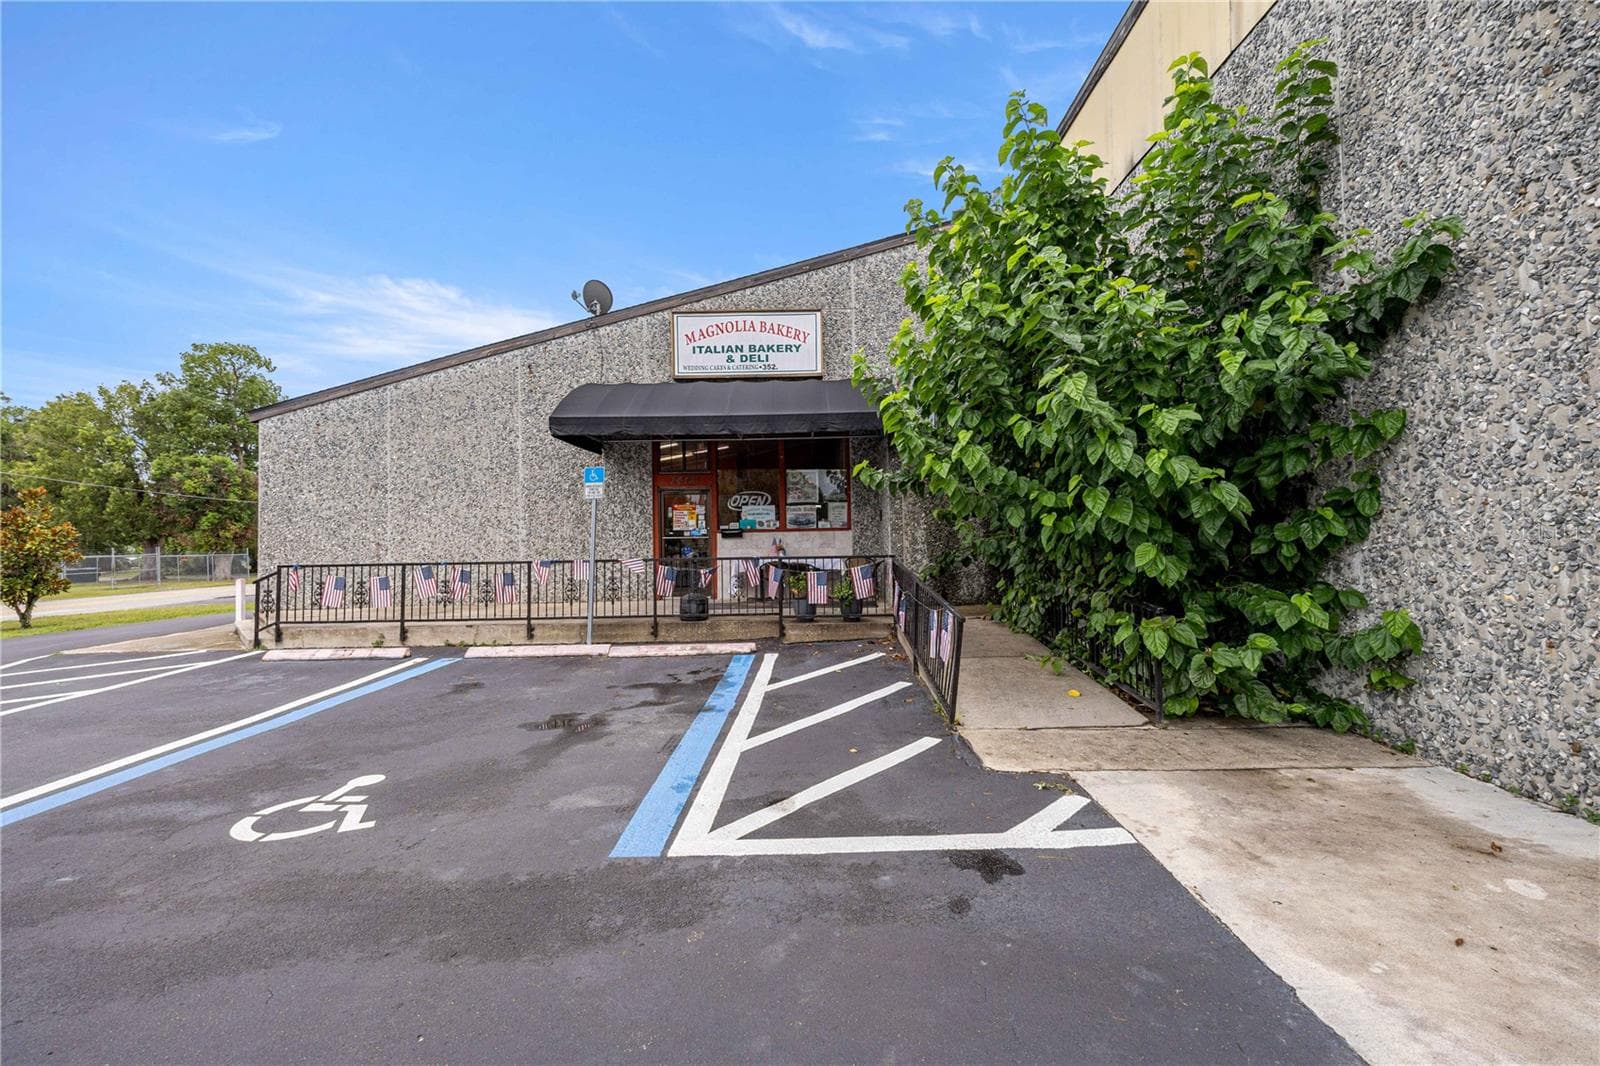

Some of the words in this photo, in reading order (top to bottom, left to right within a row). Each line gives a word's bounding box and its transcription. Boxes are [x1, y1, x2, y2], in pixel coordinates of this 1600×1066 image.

[684, 319, 756, 345] MAGNOLIA
[759, 320, 811, 344] BAKERY
[692, 345, 744, 354] ITALIAN
[748, 344, 802, 353] BAKERY
[726, 354, 735, 363] &
[740, 354, 769, 362] DELI
[730, 495, 766, 506] OPEN
